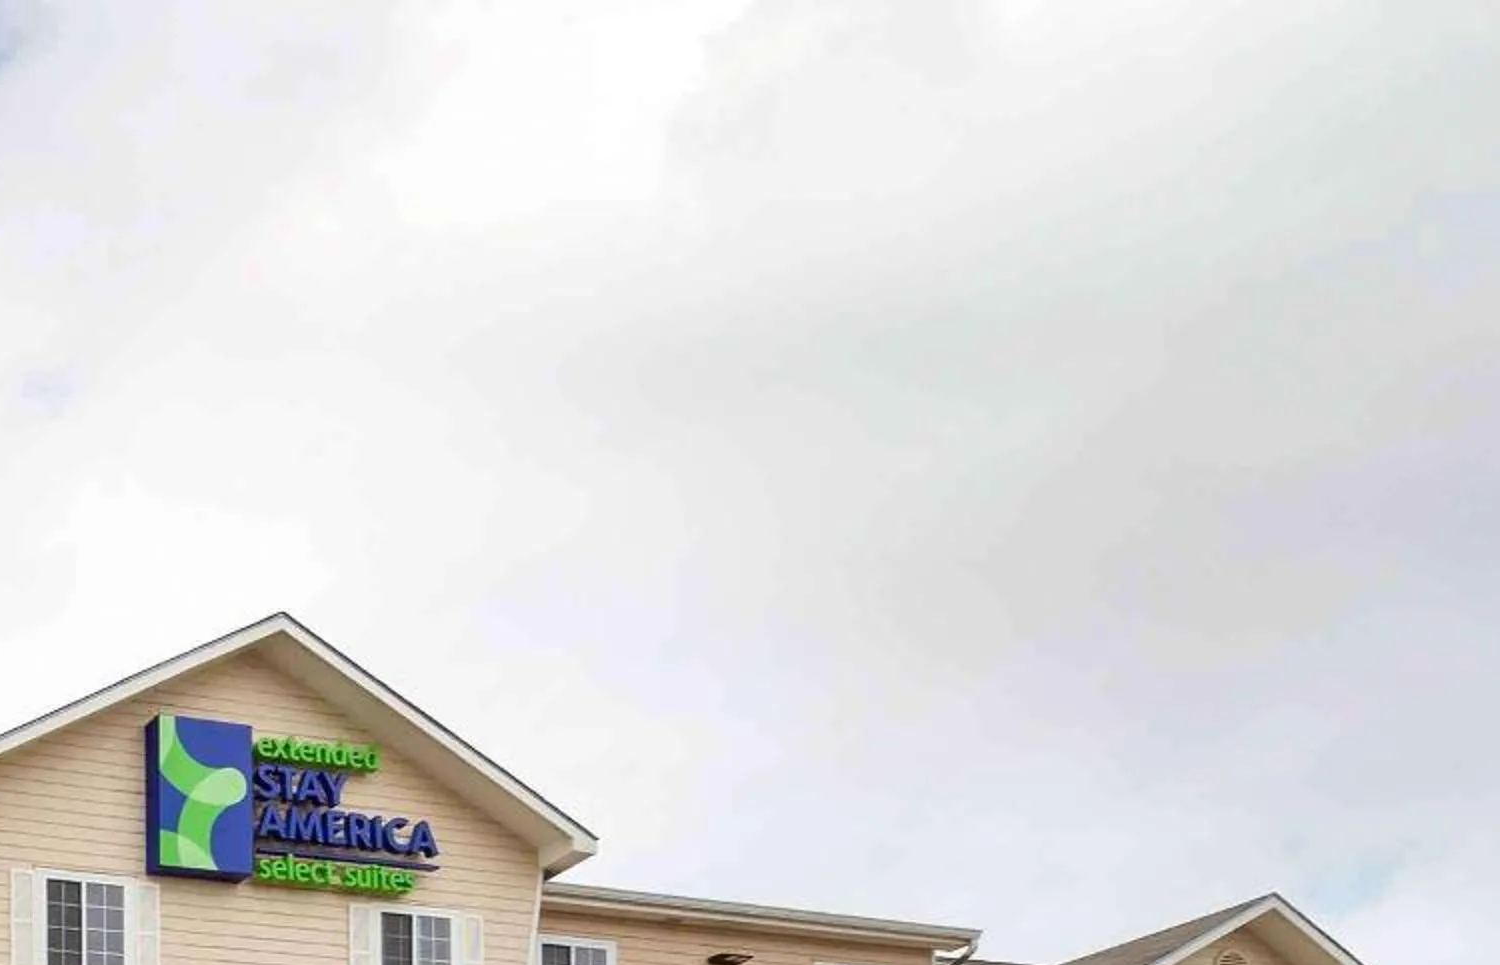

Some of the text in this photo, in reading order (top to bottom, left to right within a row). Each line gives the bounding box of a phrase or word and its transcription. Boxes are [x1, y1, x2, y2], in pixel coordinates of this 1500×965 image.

[257, 737, 381, 770] extended
[256, 763, 348, 804] STAY
[258, 803, 438, 855] AMERICA
[259, 854, 415, 893] select suites
